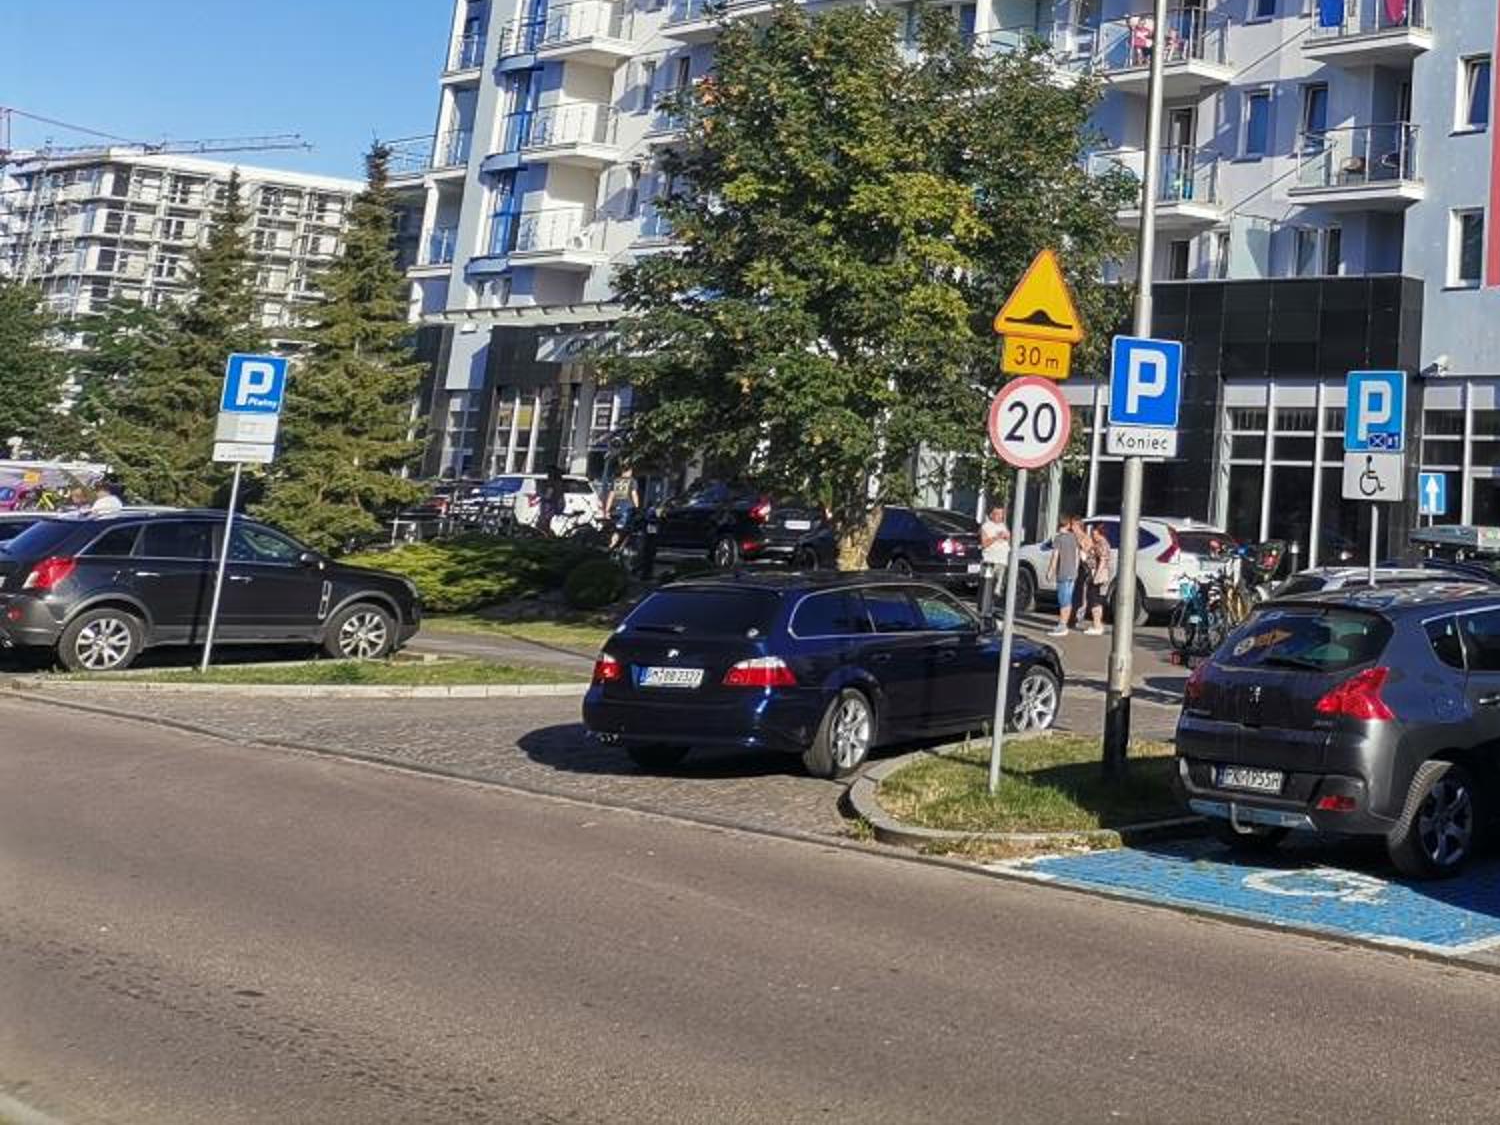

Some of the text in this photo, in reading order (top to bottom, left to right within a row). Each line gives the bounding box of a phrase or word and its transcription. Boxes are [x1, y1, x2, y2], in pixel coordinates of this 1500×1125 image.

[1014, 344, 1060, 370] 30 m
[235, 362, 275, 406] P
[1125, 348, 1168, 414] P
[1003, 400, 1058, 444] 20
[1357, 379, 1393, 442] P
[1115, 432, 1169, 451] Koniec
